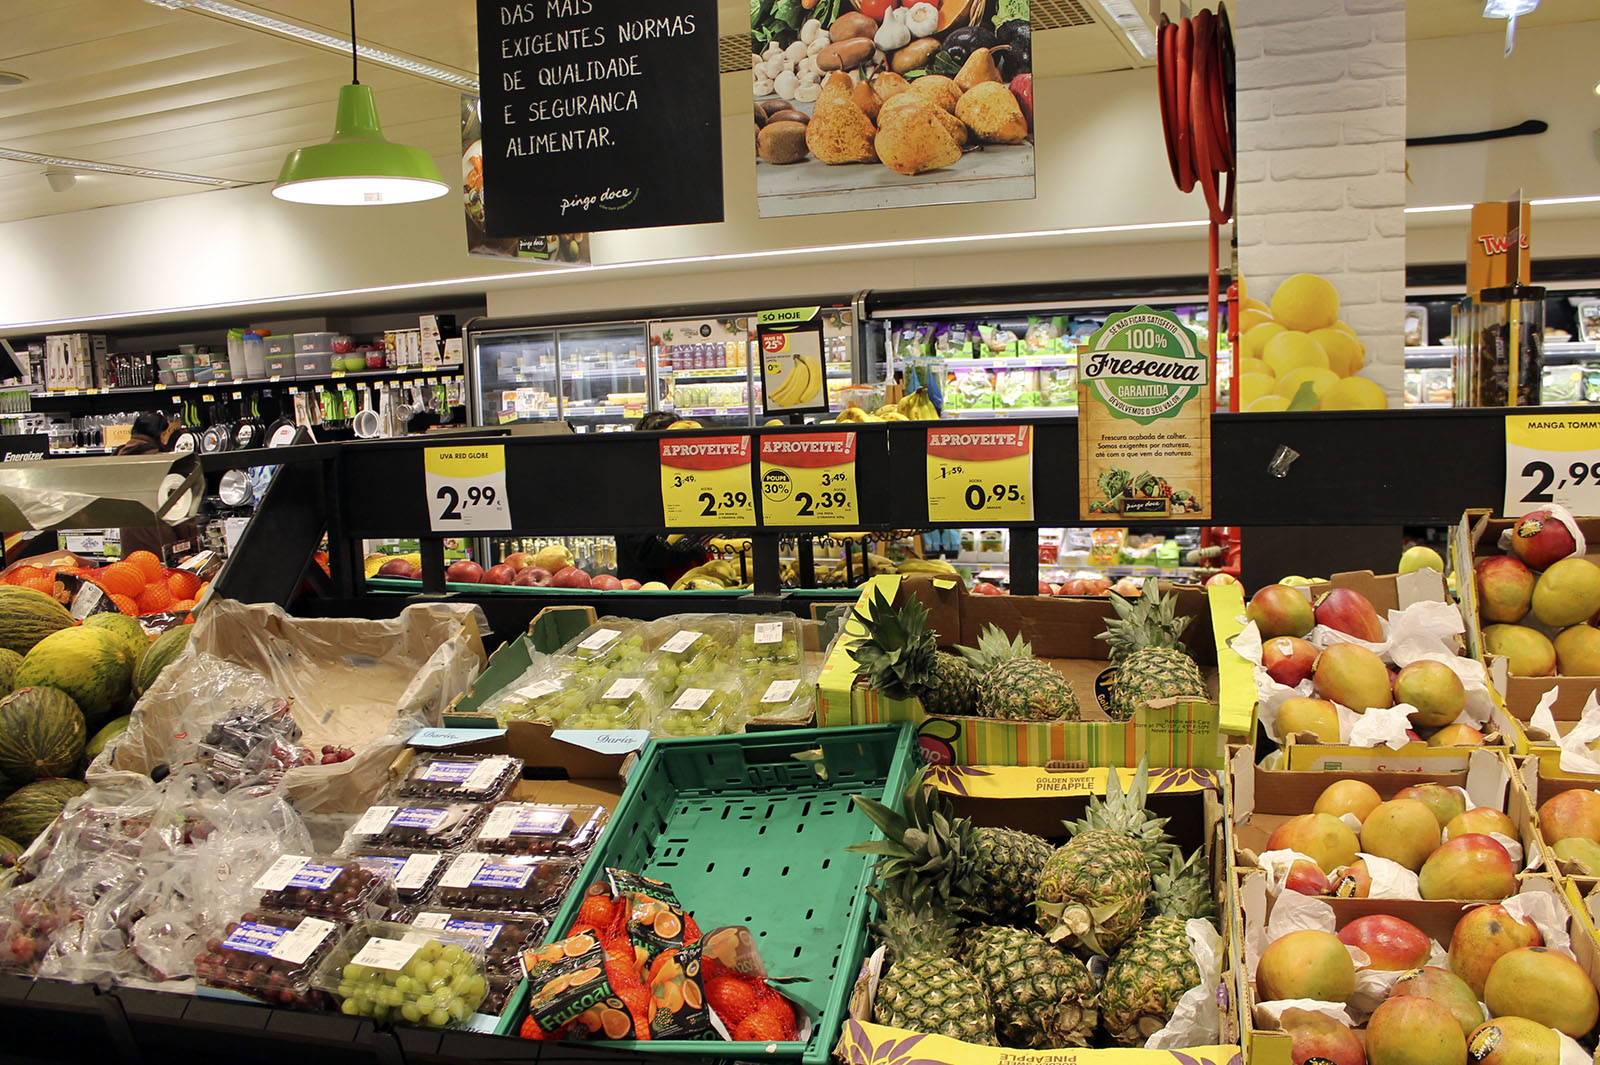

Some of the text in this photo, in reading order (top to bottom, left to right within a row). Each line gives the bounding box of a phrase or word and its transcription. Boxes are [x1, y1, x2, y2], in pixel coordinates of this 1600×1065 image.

[500, 0, 593, 26] DAS MAIS
[502, 14, 696, 59] EXIGENTES NORMAS
[503, 54, 642, 92] DE QUALIDADE
[504, 90, 638, 125] E SEGURANCA
[505, 126, 616, 158] ALIMENTAR.
[560, 194, 597, 216] pingo
[600, 187, 632, 202] doce
[1479, 234, 1528, 255] Twx
[762, 312, 800, 321] SÓ HOJE
[1109, 316, 1178, 336] SE NÃO FICAR SATISFEITO
[1125, 328, 1168, 349] 100%
[1086, 353, 1200, 381] Frescura
[1118, 384, 1168, 398] GARANTIDA
[1108, 396, 1144, 415] DEVOLVEMOS
[1152, 406, 1163, 415] SEU
[1163, 395, 1180, 410] VALOR
[662, 435, 750, 457] APROVEITE!
[762, 432, 855, 454] APROVEITE!
[930, 425, 1028, 447] APROVEITE!
[764, 484, 790, 494] 30%
[1098, 694, 1112, 711] Gold
[1036, 782, 1094, 791] PINEAPPLE
[540, 981, 611, 1031] Frusoal
[1000, 1053, 1077, 1064] PINEAPPLE
